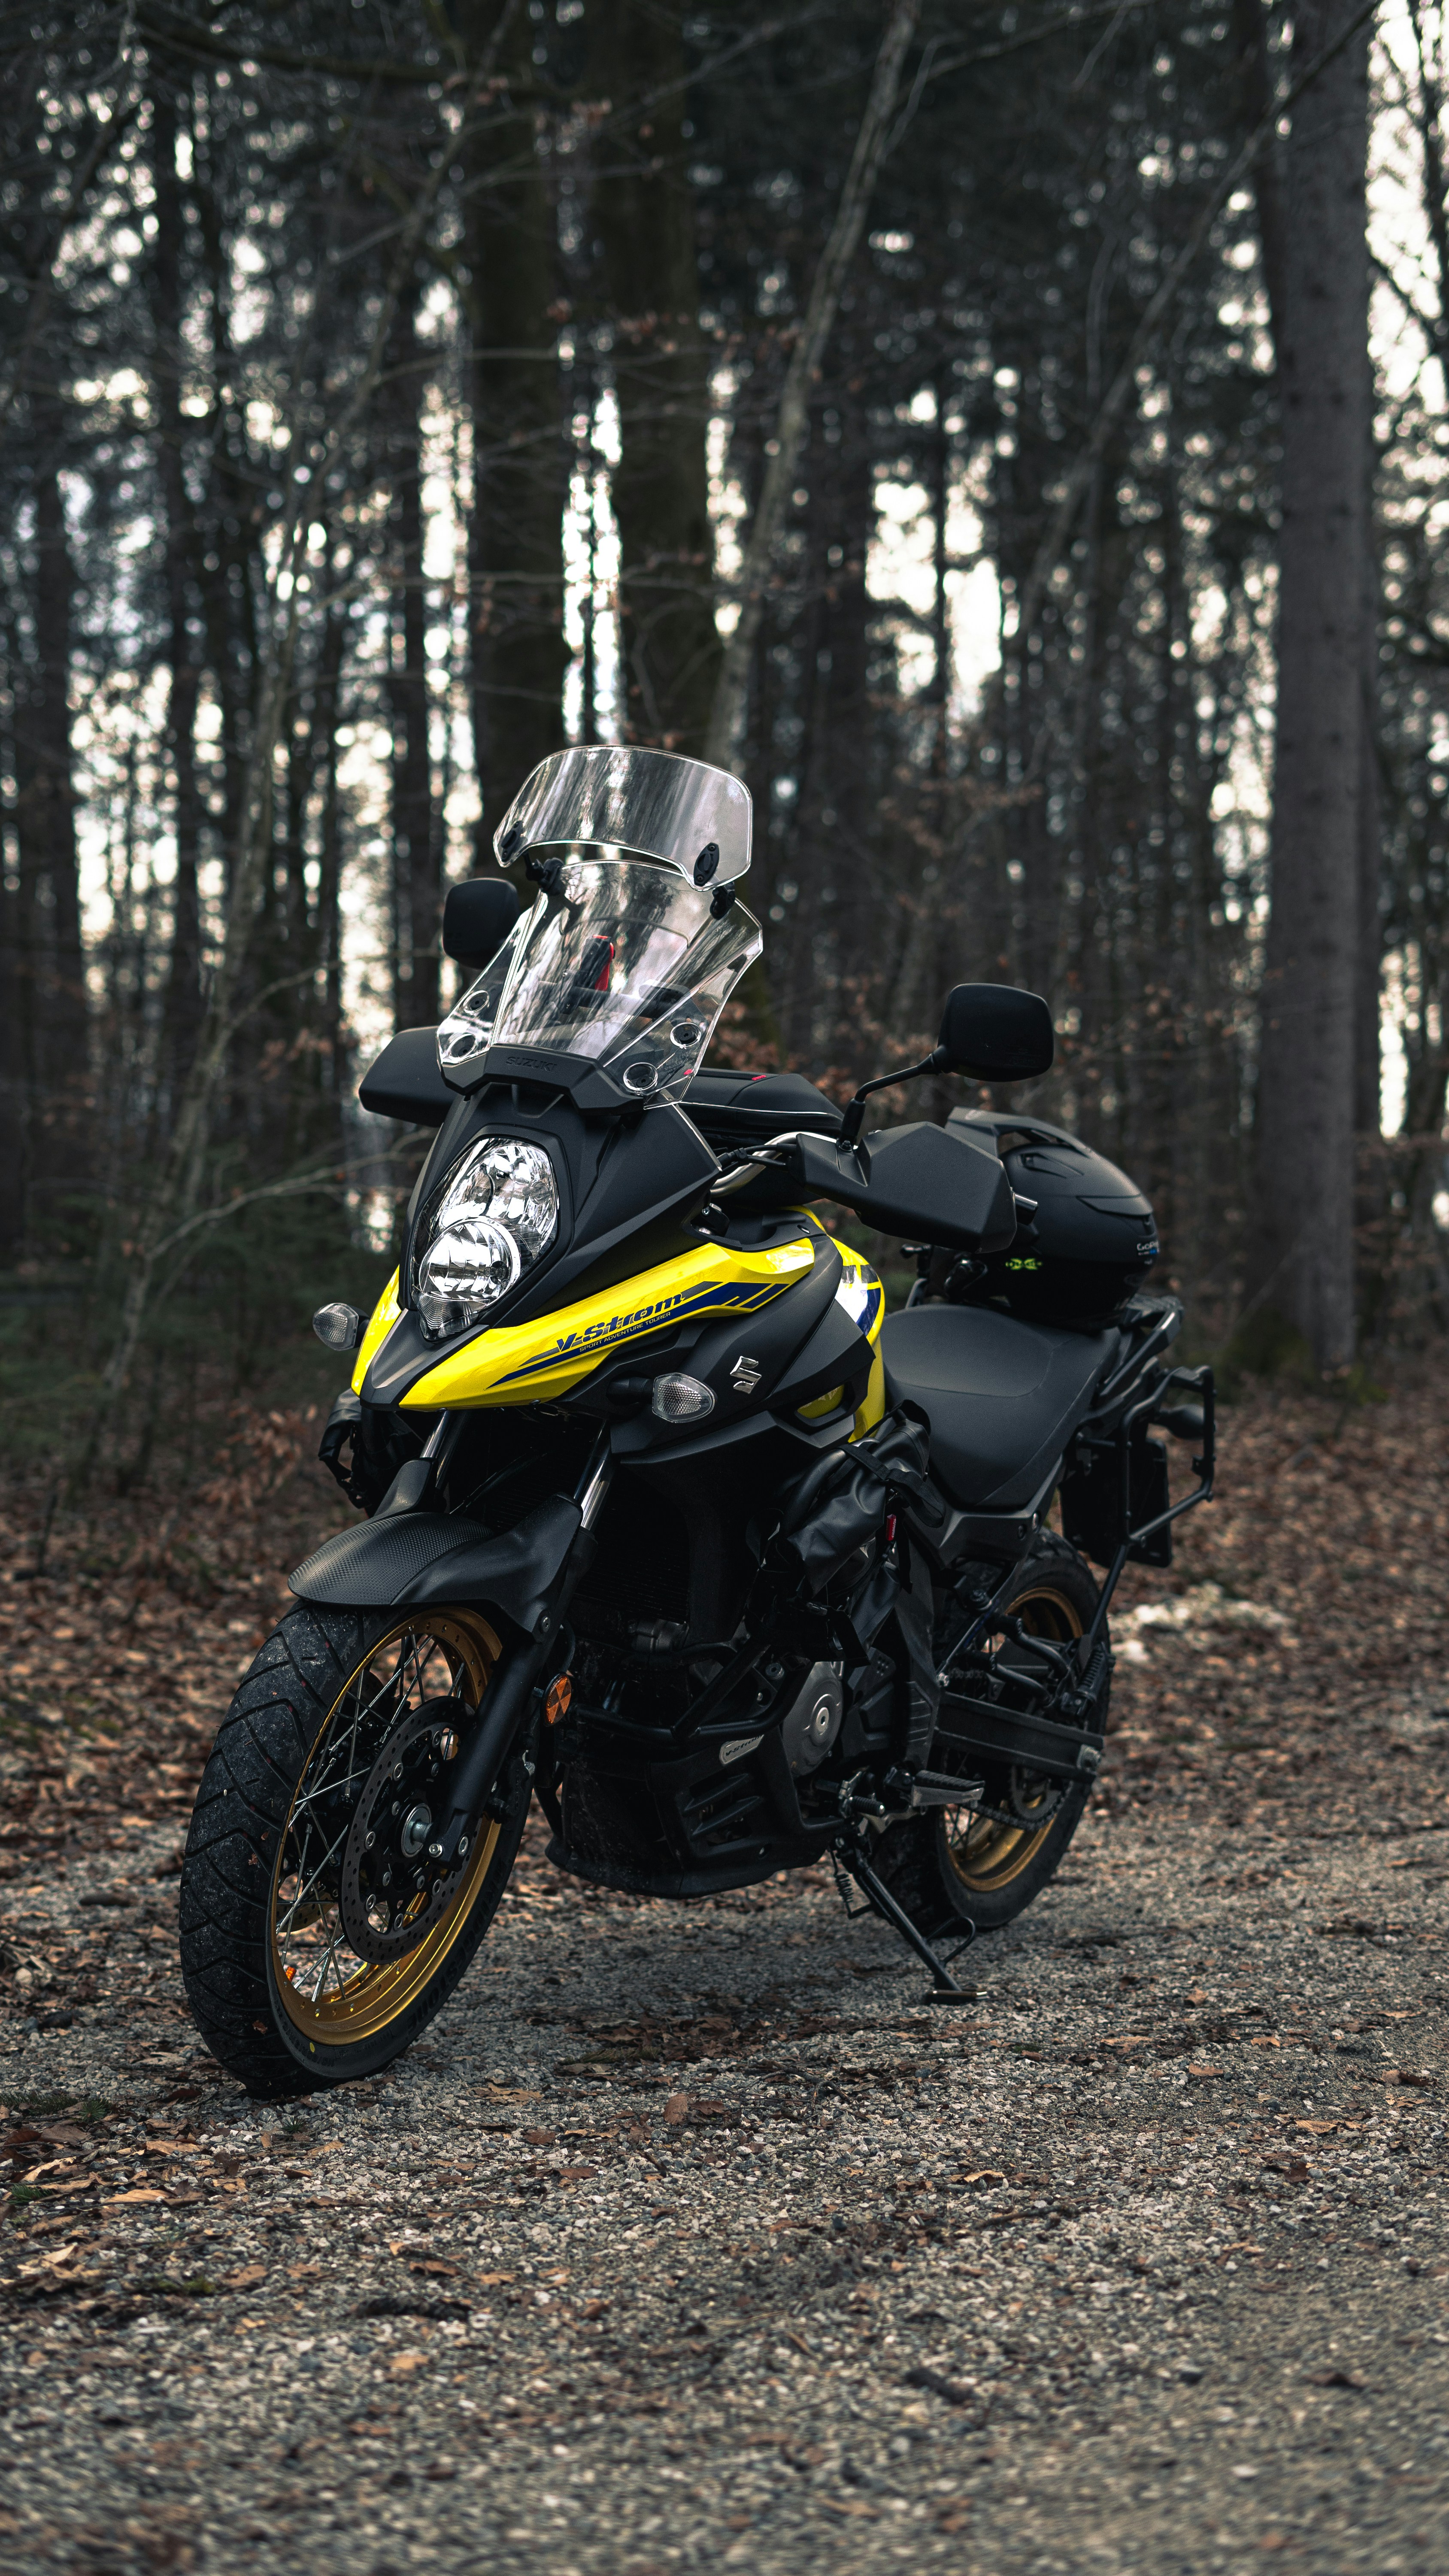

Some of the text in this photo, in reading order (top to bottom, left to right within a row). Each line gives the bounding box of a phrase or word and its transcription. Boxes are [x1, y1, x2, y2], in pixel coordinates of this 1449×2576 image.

[506, 1057, 558, 1073] SUZUKI
[556, 1293, 682, 1352] V-Strom
[579, 1312, 671, 1352] SPORT ADVENTURE TOURER
